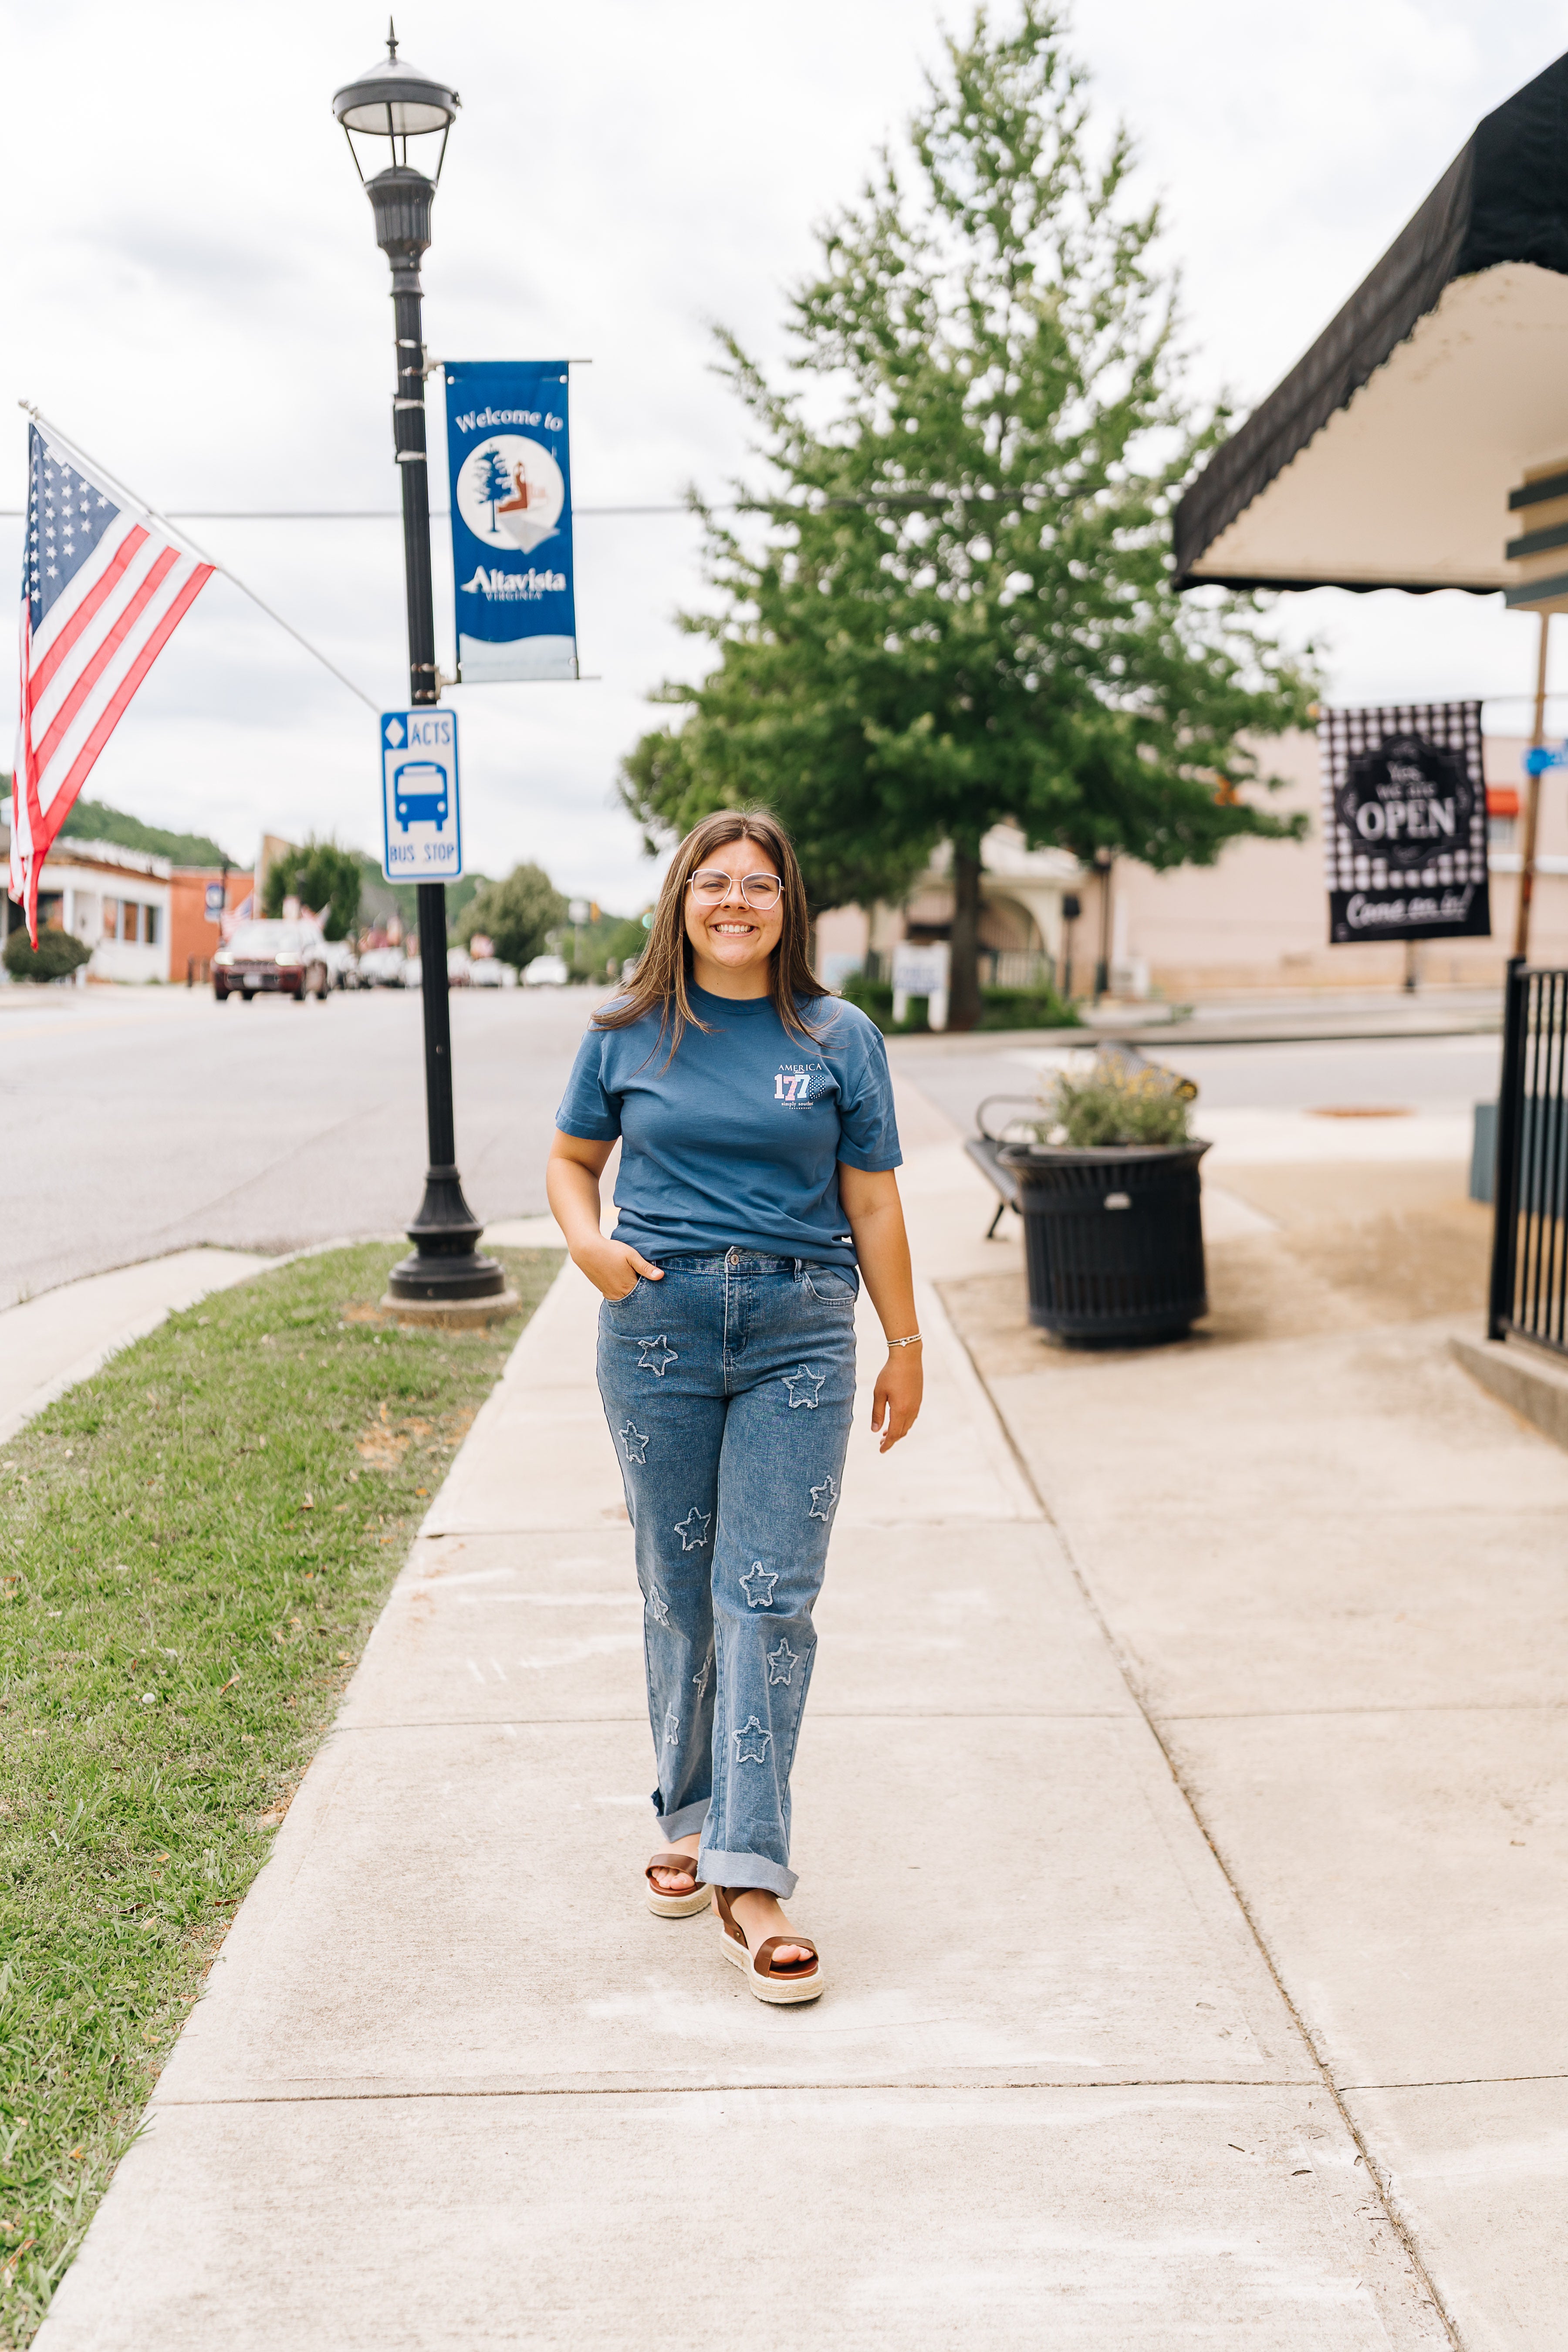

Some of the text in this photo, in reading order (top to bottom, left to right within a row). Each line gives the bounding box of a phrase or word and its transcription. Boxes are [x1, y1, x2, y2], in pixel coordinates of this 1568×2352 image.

[455, 406, 564, 434] Welcome to
[460, 565, 566, 594] Altavista
[485, 591, 543, 602] VIRGINIA
[412, 721, 450, 745] ACTS
[1356, 797, 1456, 841] OPEN
[390, 843, 454, 862] BUS STOP
[1346, 893, 1406, 929] Come
[774, 1074, 826, 1101] 1776
